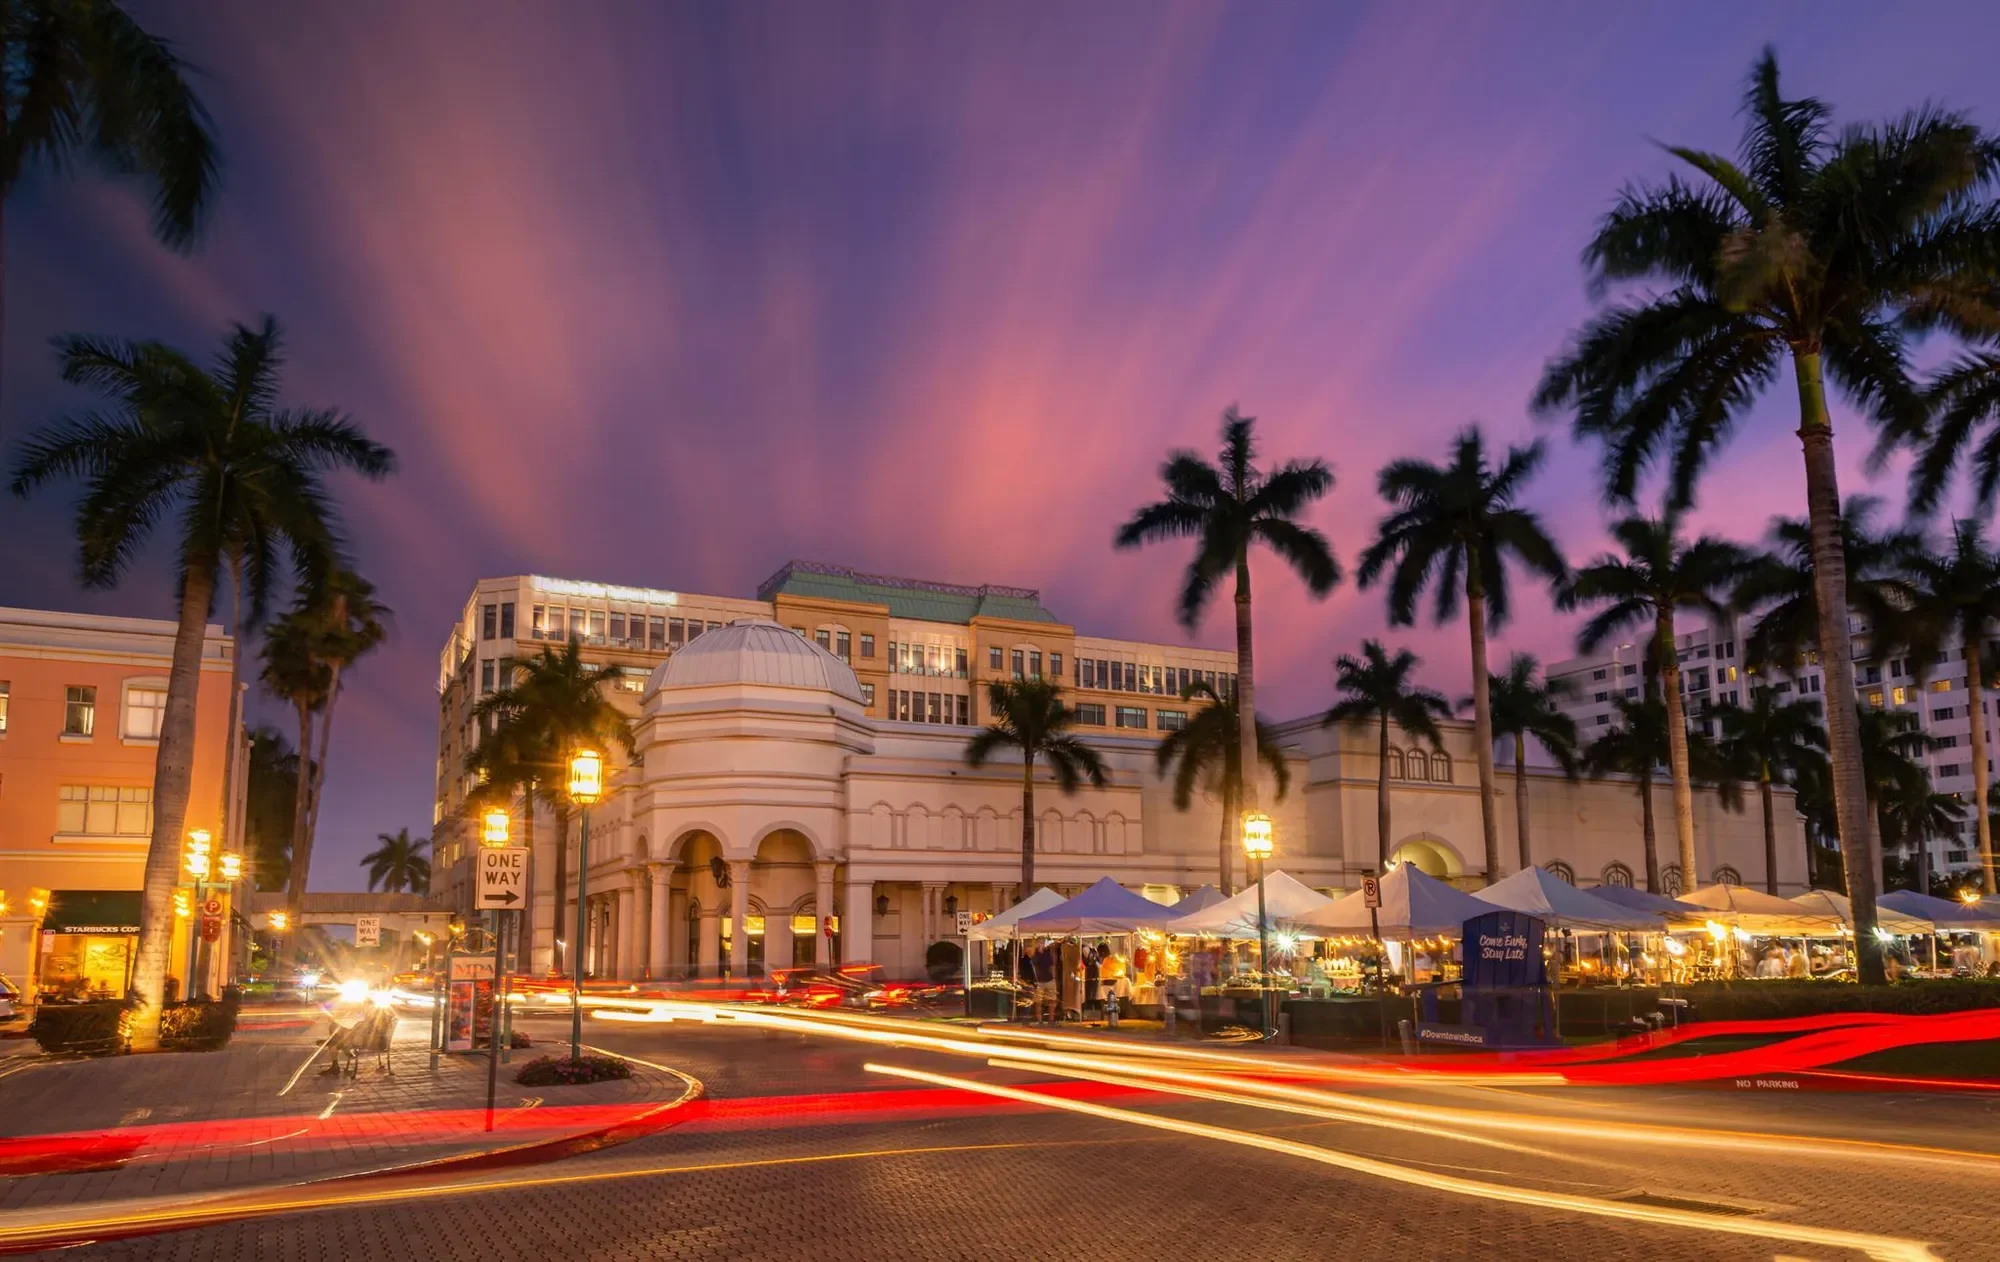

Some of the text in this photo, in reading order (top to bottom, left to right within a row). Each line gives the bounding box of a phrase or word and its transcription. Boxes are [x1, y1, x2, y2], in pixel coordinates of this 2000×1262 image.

[487, 853, 521, 868] ONE
[485, 871, 521, 886] WAY
[210, 901, 218, 911] P
[359, 927, 377, 935] WAY
[1480, 934, 1503, 948] Come
[1482, 947, 1525, 962] Stay Late
[1421, 1029, 1484, 1044] #DowntownBoca
[1736, 1079, 1800, 1089] NO PARKING
